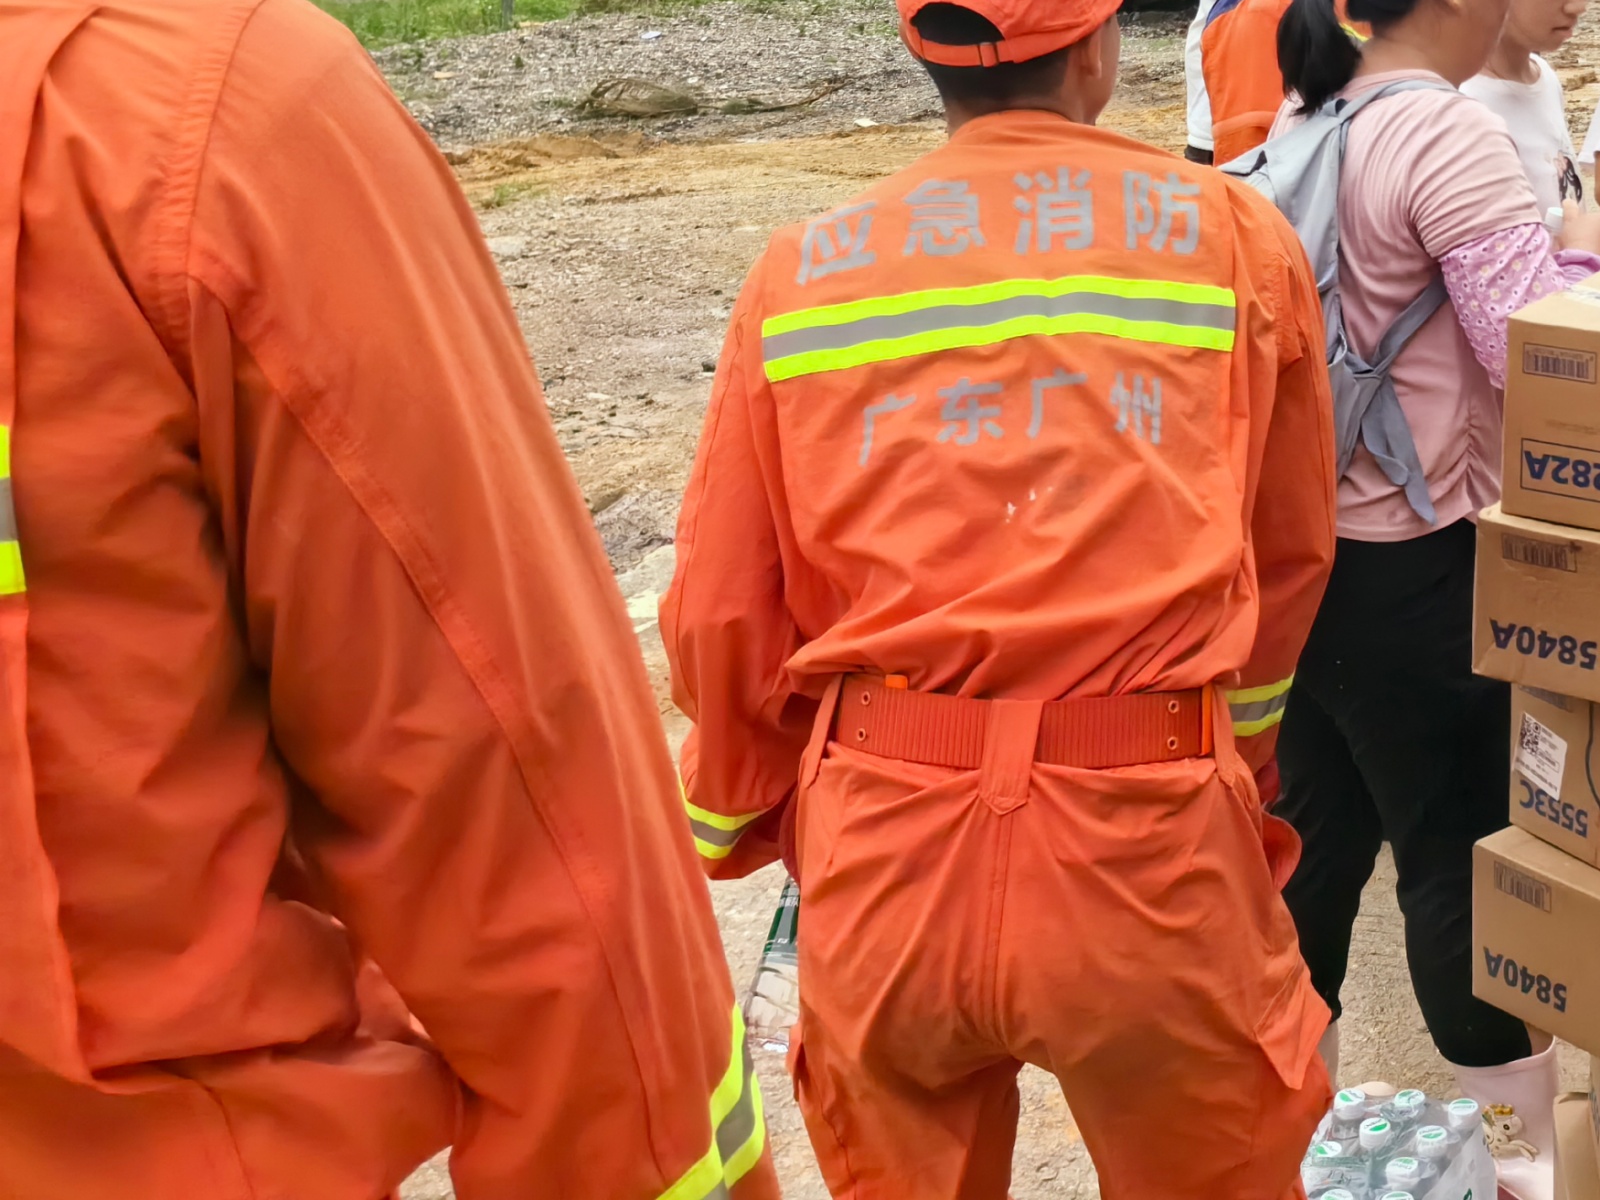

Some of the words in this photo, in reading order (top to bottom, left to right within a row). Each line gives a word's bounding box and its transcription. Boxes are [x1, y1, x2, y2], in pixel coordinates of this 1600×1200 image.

[796, 166, 1202, 285] 应急消防
[857, 368, 1163, 466] 广东广州
[1489, 618, 1597, 671] 5840A
[1519, 779, 1588, 838] 5553C
[1483, 946, 1567, 1012] 5840A
